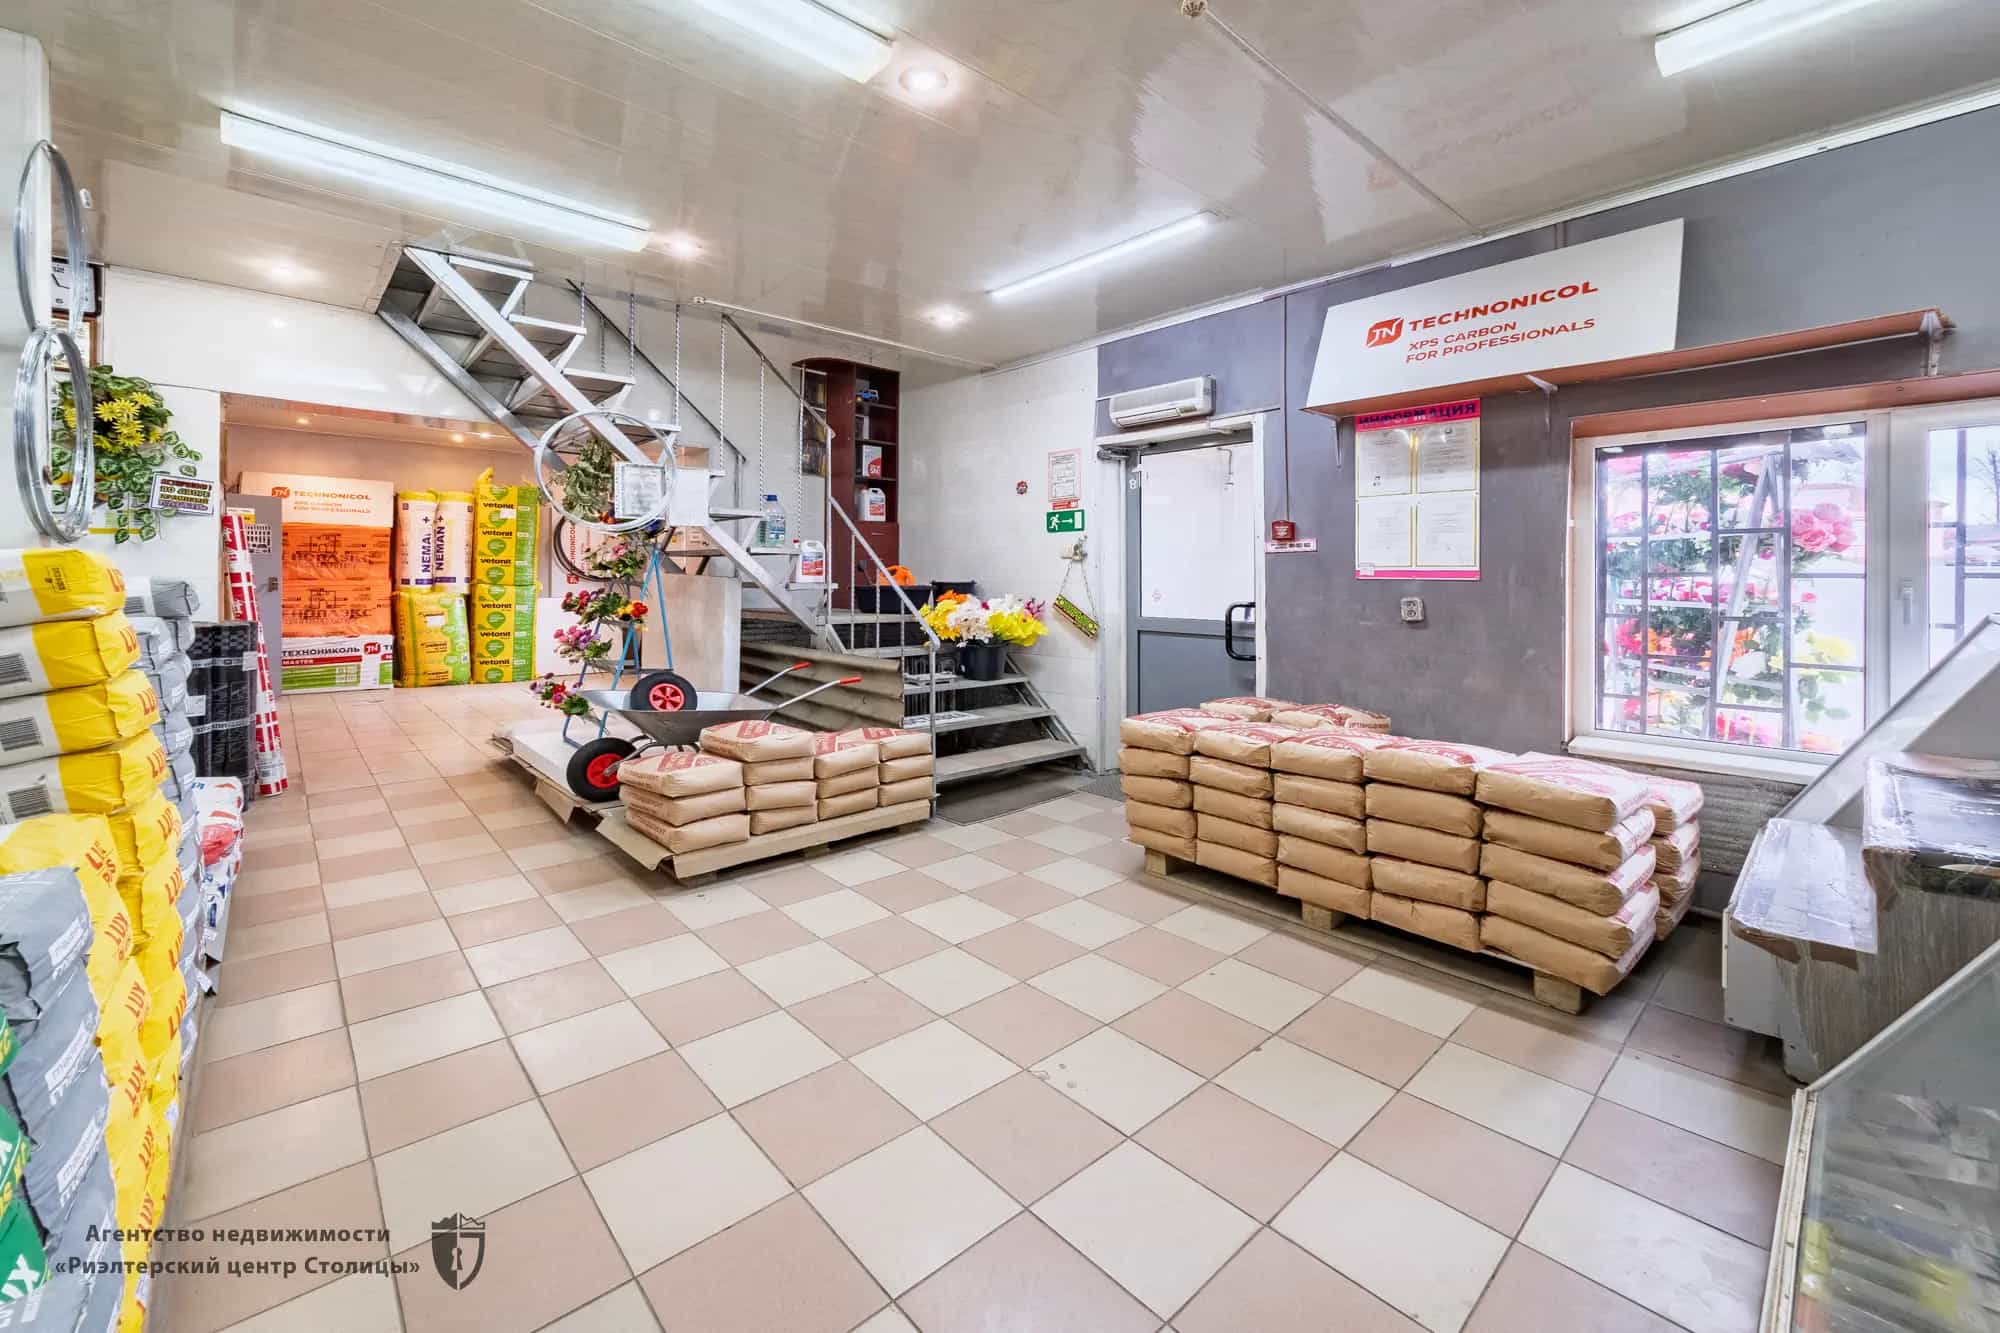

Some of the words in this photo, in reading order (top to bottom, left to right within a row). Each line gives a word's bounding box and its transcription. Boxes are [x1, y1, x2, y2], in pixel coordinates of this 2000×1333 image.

[1408, 281, 1598, 332] TECHNONICOL
[1406, 349, 1438, 363] FOR
[1443, 318, 1596, 357] PROFESSIONALS
[1409, 337, 1439, 352] XPS
[1444, 321, 1517, 344] CARBON
[421, 533, 432, 573] NEMA
[435, 526, 445, 571] NEMAN
[282, 646, 361, 657] ТЕХНОНИКОЛЬ
[125, 1060, 145, 1104] LUX
